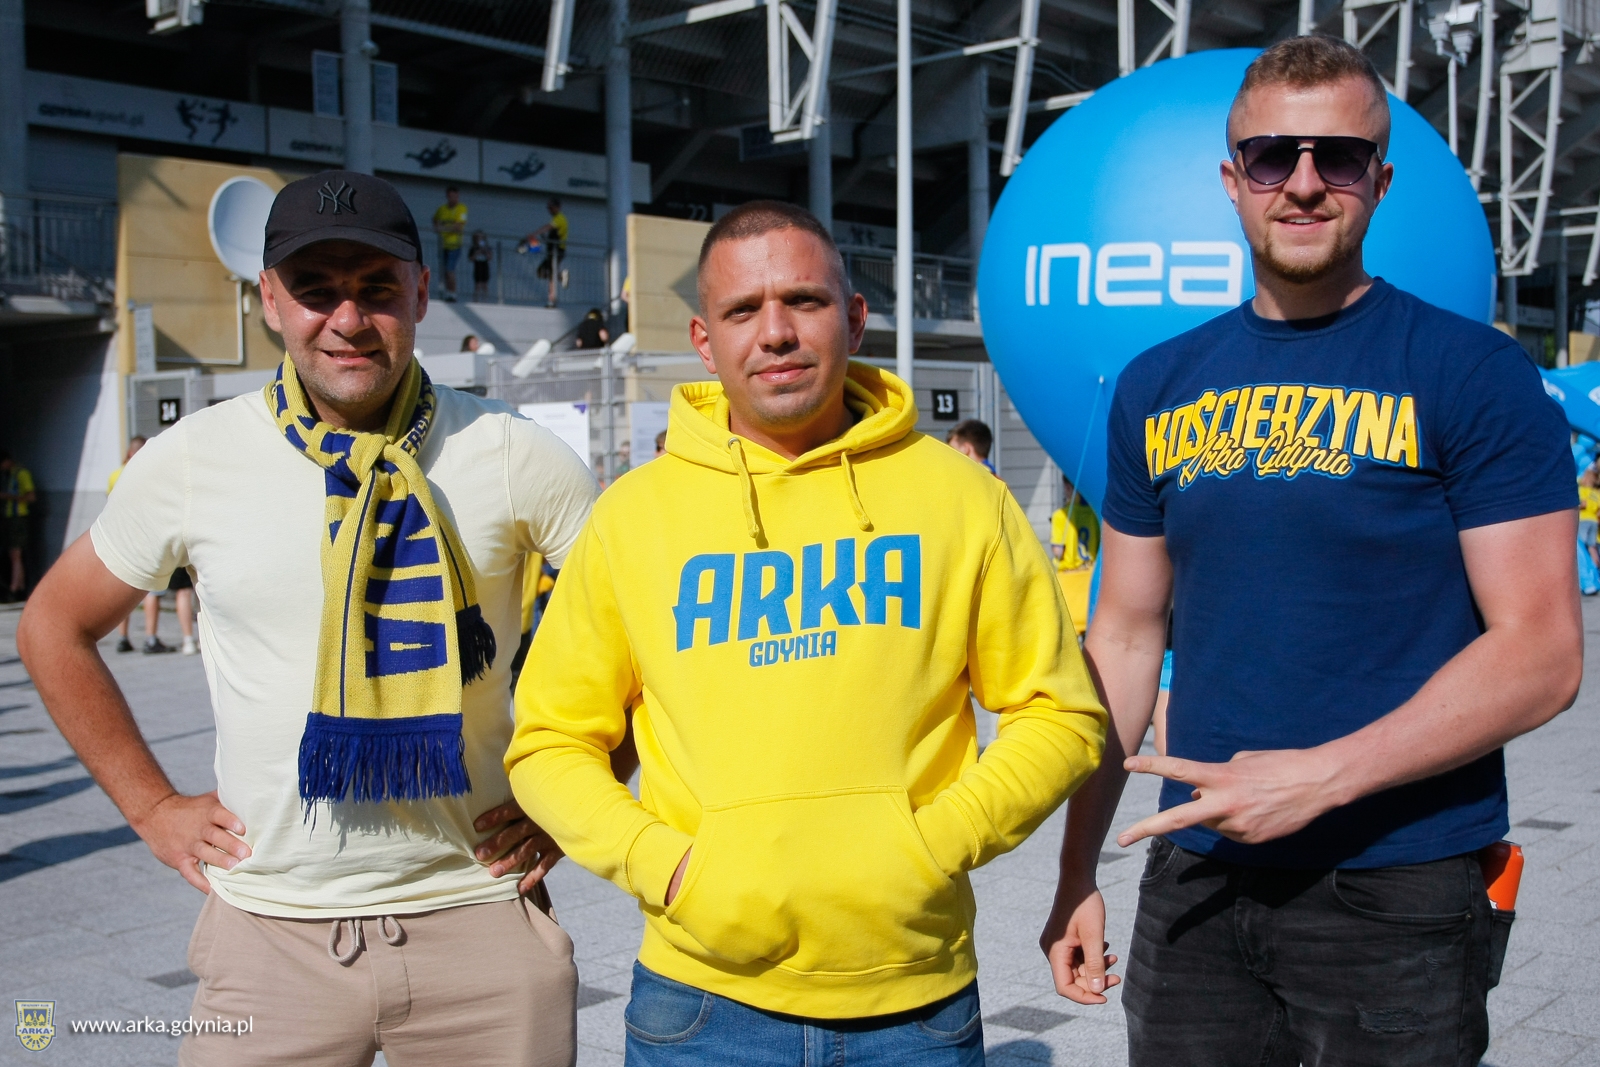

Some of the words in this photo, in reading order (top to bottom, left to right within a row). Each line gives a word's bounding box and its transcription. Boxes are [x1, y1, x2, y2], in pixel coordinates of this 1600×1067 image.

[1025, 242, 1243, 307] inea
[936, 393, 955, 414] 13
[1144, 384, 1419, 481] KOŚCIERZYNA
[1179, 432, 1246, 488] Arka
[1255, 429, 1352, 478] Gdynia
[365, 491, 447, 679] NIA
[671, 533, 921, 653] ARKA
[749, 630, 837, 668] GDYNIA
